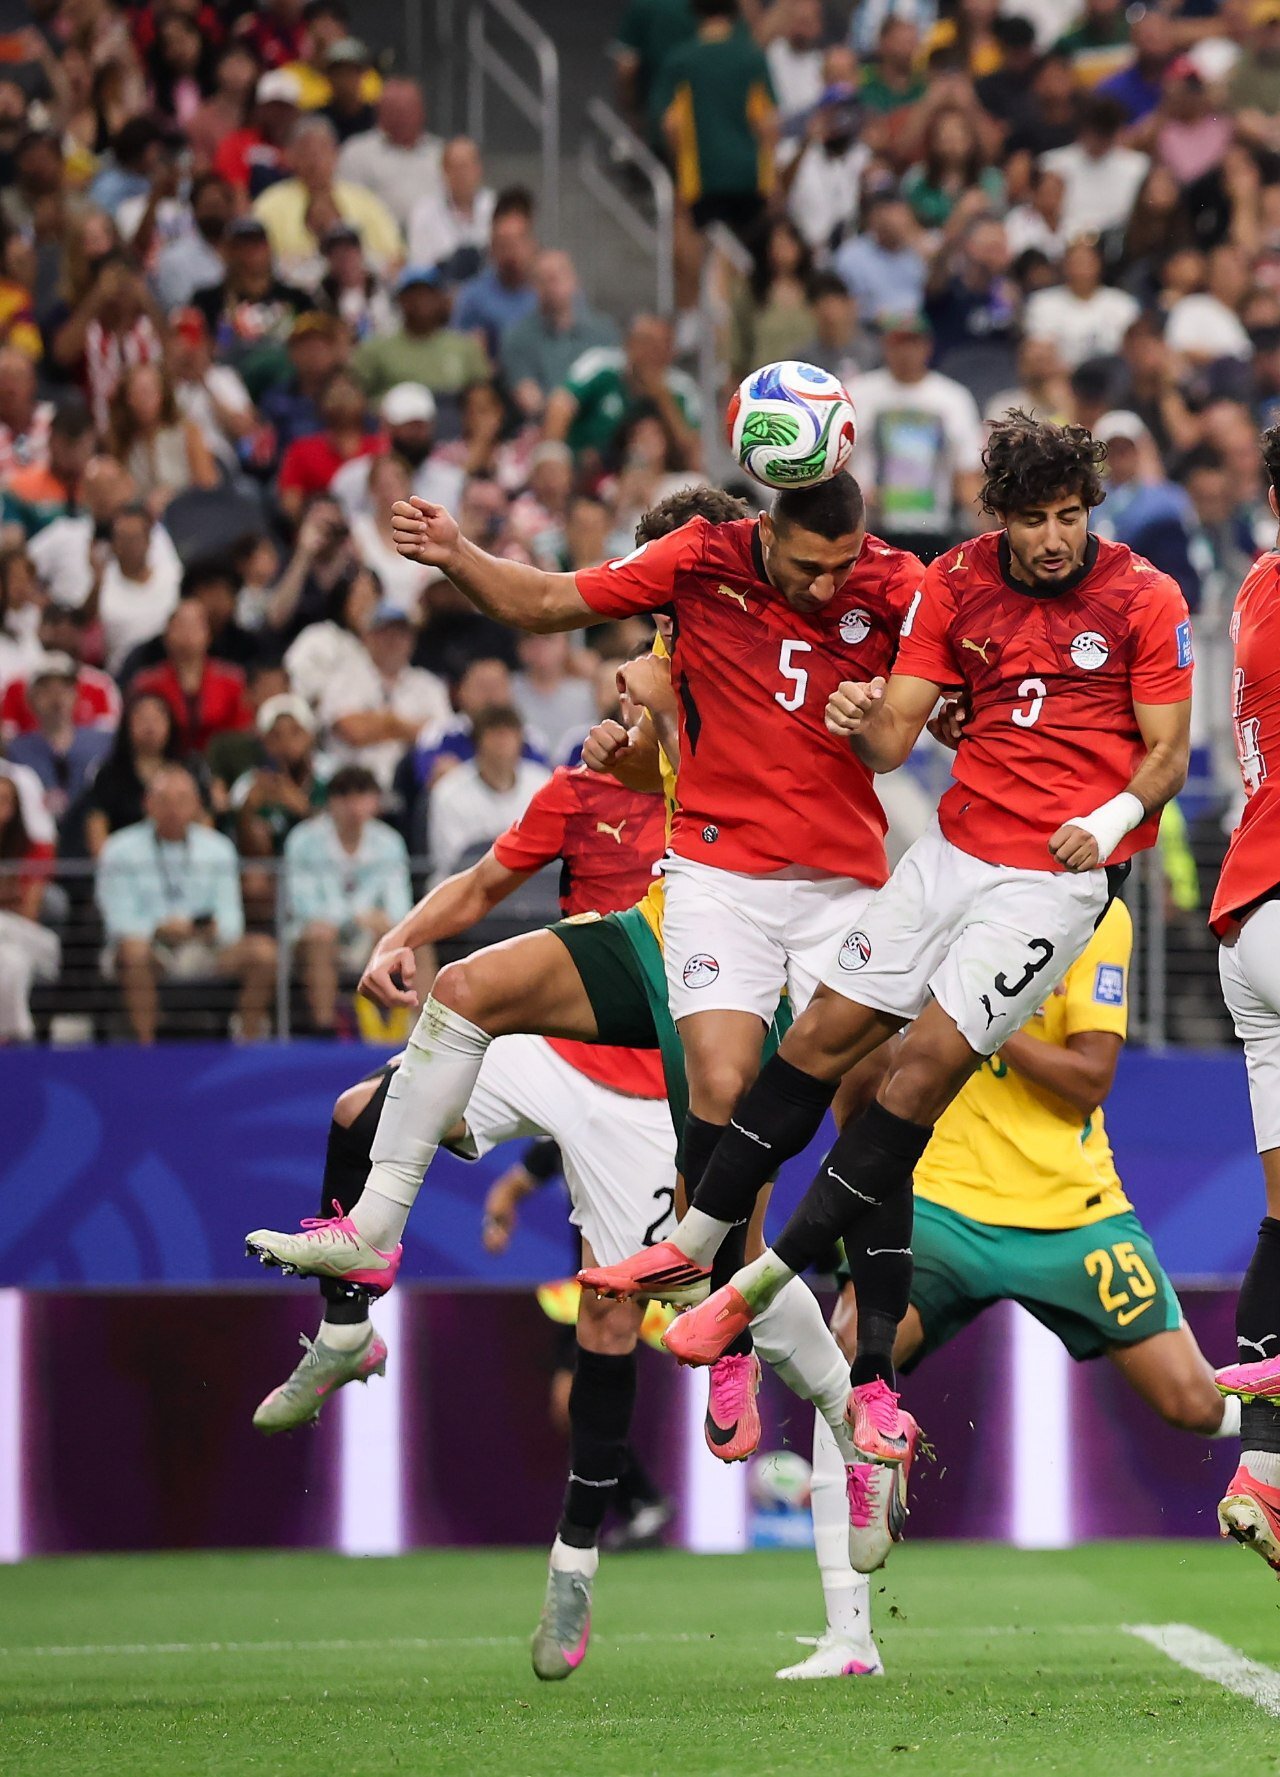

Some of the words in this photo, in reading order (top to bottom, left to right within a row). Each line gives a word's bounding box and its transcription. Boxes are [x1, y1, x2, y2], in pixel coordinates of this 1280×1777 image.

[774, 639, 812, 712] 5
[1011, 677, 1047, 728] 3
[994, 938, 1055, 998] 3
[1083, 1241, 1157, 1312] 25
